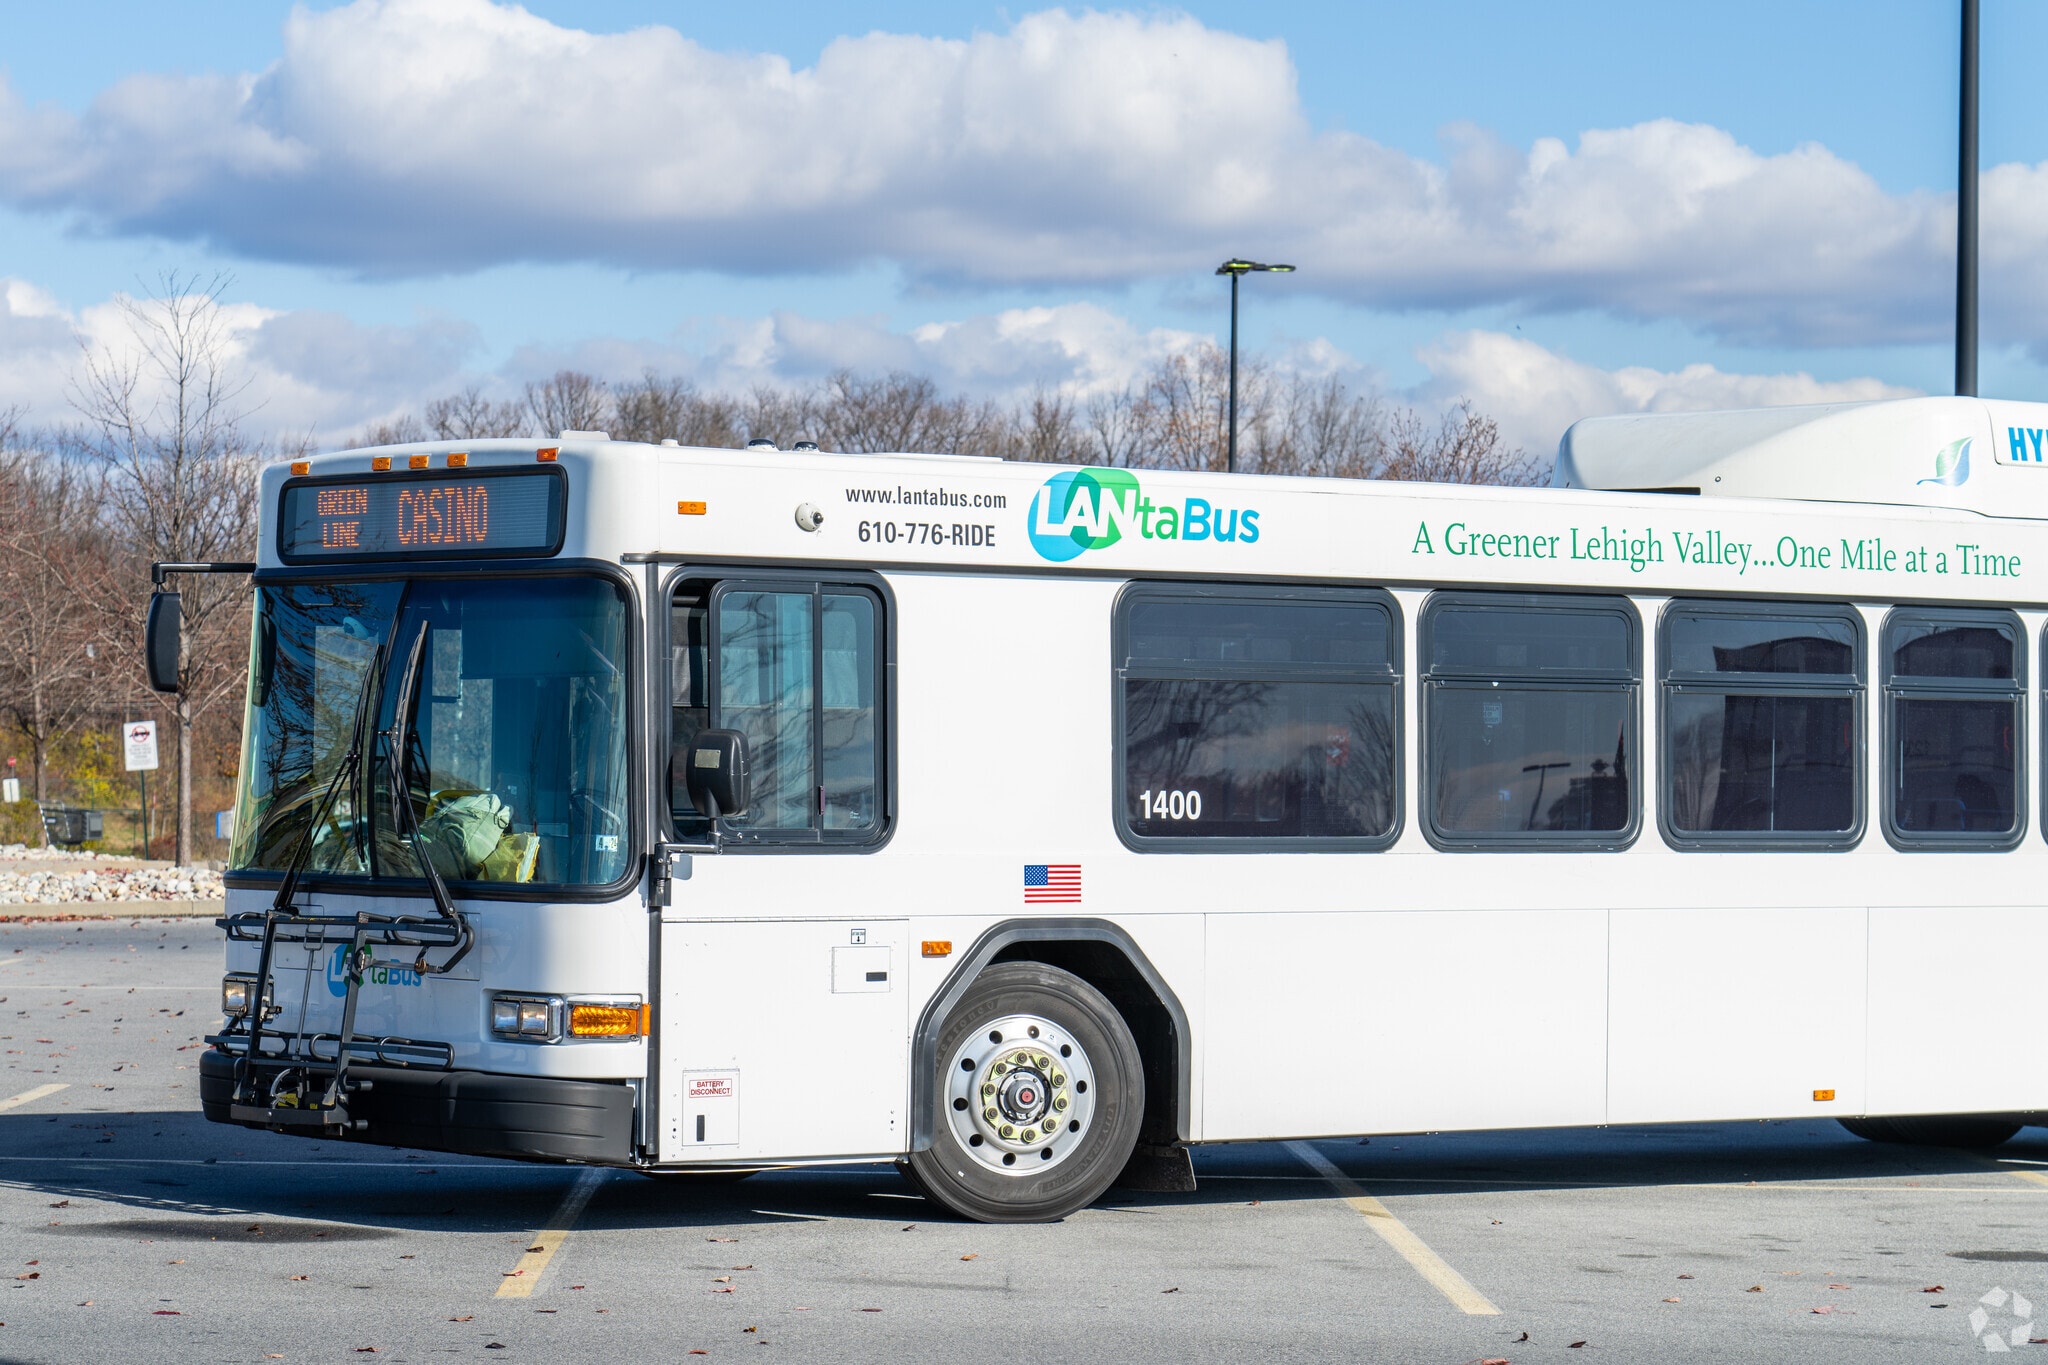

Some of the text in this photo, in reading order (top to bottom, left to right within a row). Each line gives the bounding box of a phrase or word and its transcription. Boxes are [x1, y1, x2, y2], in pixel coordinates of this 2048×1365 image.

[2008, 427, 2048, 462] HY
[317, 488, 368, 516] GREEN
[845, 486, 1007, 509] www.lantabus.com
[398, 486, 488, 545] CASINO
[322, 521, 361, 548] LINE
[858, 521, 996, 547] 610-776-RIDE
[1412, 521, 1434, 555] A
[1444, 523, 1560, 559] Greener
[1570, 526, 1664, 573] Lehigh
[1841, 537, 1897, 572] Mile
[1905, 547, 1927, 573] at
[1935, 552, 1949, 575] a
[1955, 544, 2021, 577] Time
[1139, 789, 1202, 820] 1400
[690, 1087, 731, 1095] DISCONNECT
[696, 1080, 724, 1088] BATTERY
